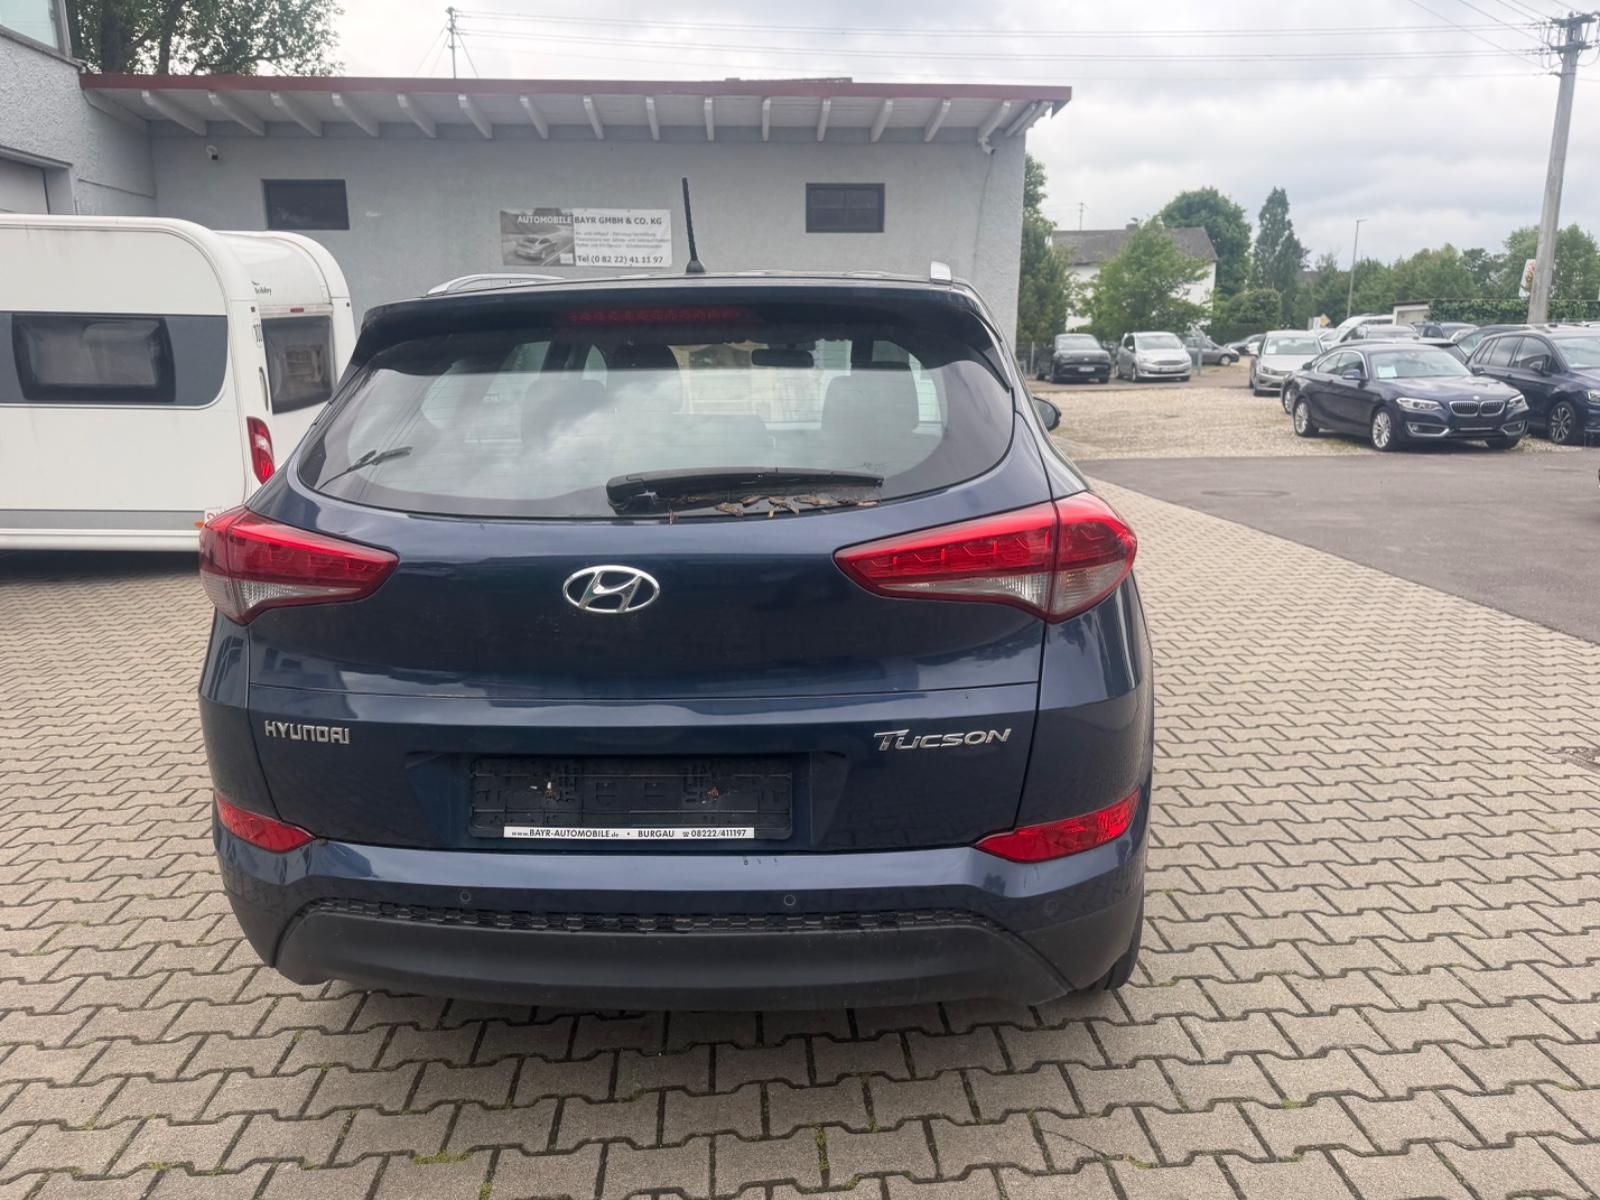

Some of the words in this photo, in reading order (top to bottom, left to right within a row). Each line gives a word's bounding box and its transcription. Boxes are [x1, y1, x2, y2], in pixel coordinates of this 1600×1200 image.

[517, 215, 572, 225] AUTOMOBILE
[574, 215, 597, 225] BAYR
[599, 216, 624, 225] GMBH
[625, 217, 632, 225] &
[634, 217, 649, 225] CO.
[650, 217, 662, 225] KG
[629, 256, 639, 264] 41
[641, 256, 651, 264] 11
[653, 256, 664, 264] 97
[264, 720, 350, 745] HYUNDAI
[873, 728, 1012, 752] TUCSON
[637, 829, 675, 838] BURGAU
[690, 829, 747, 838] 08222/411197
